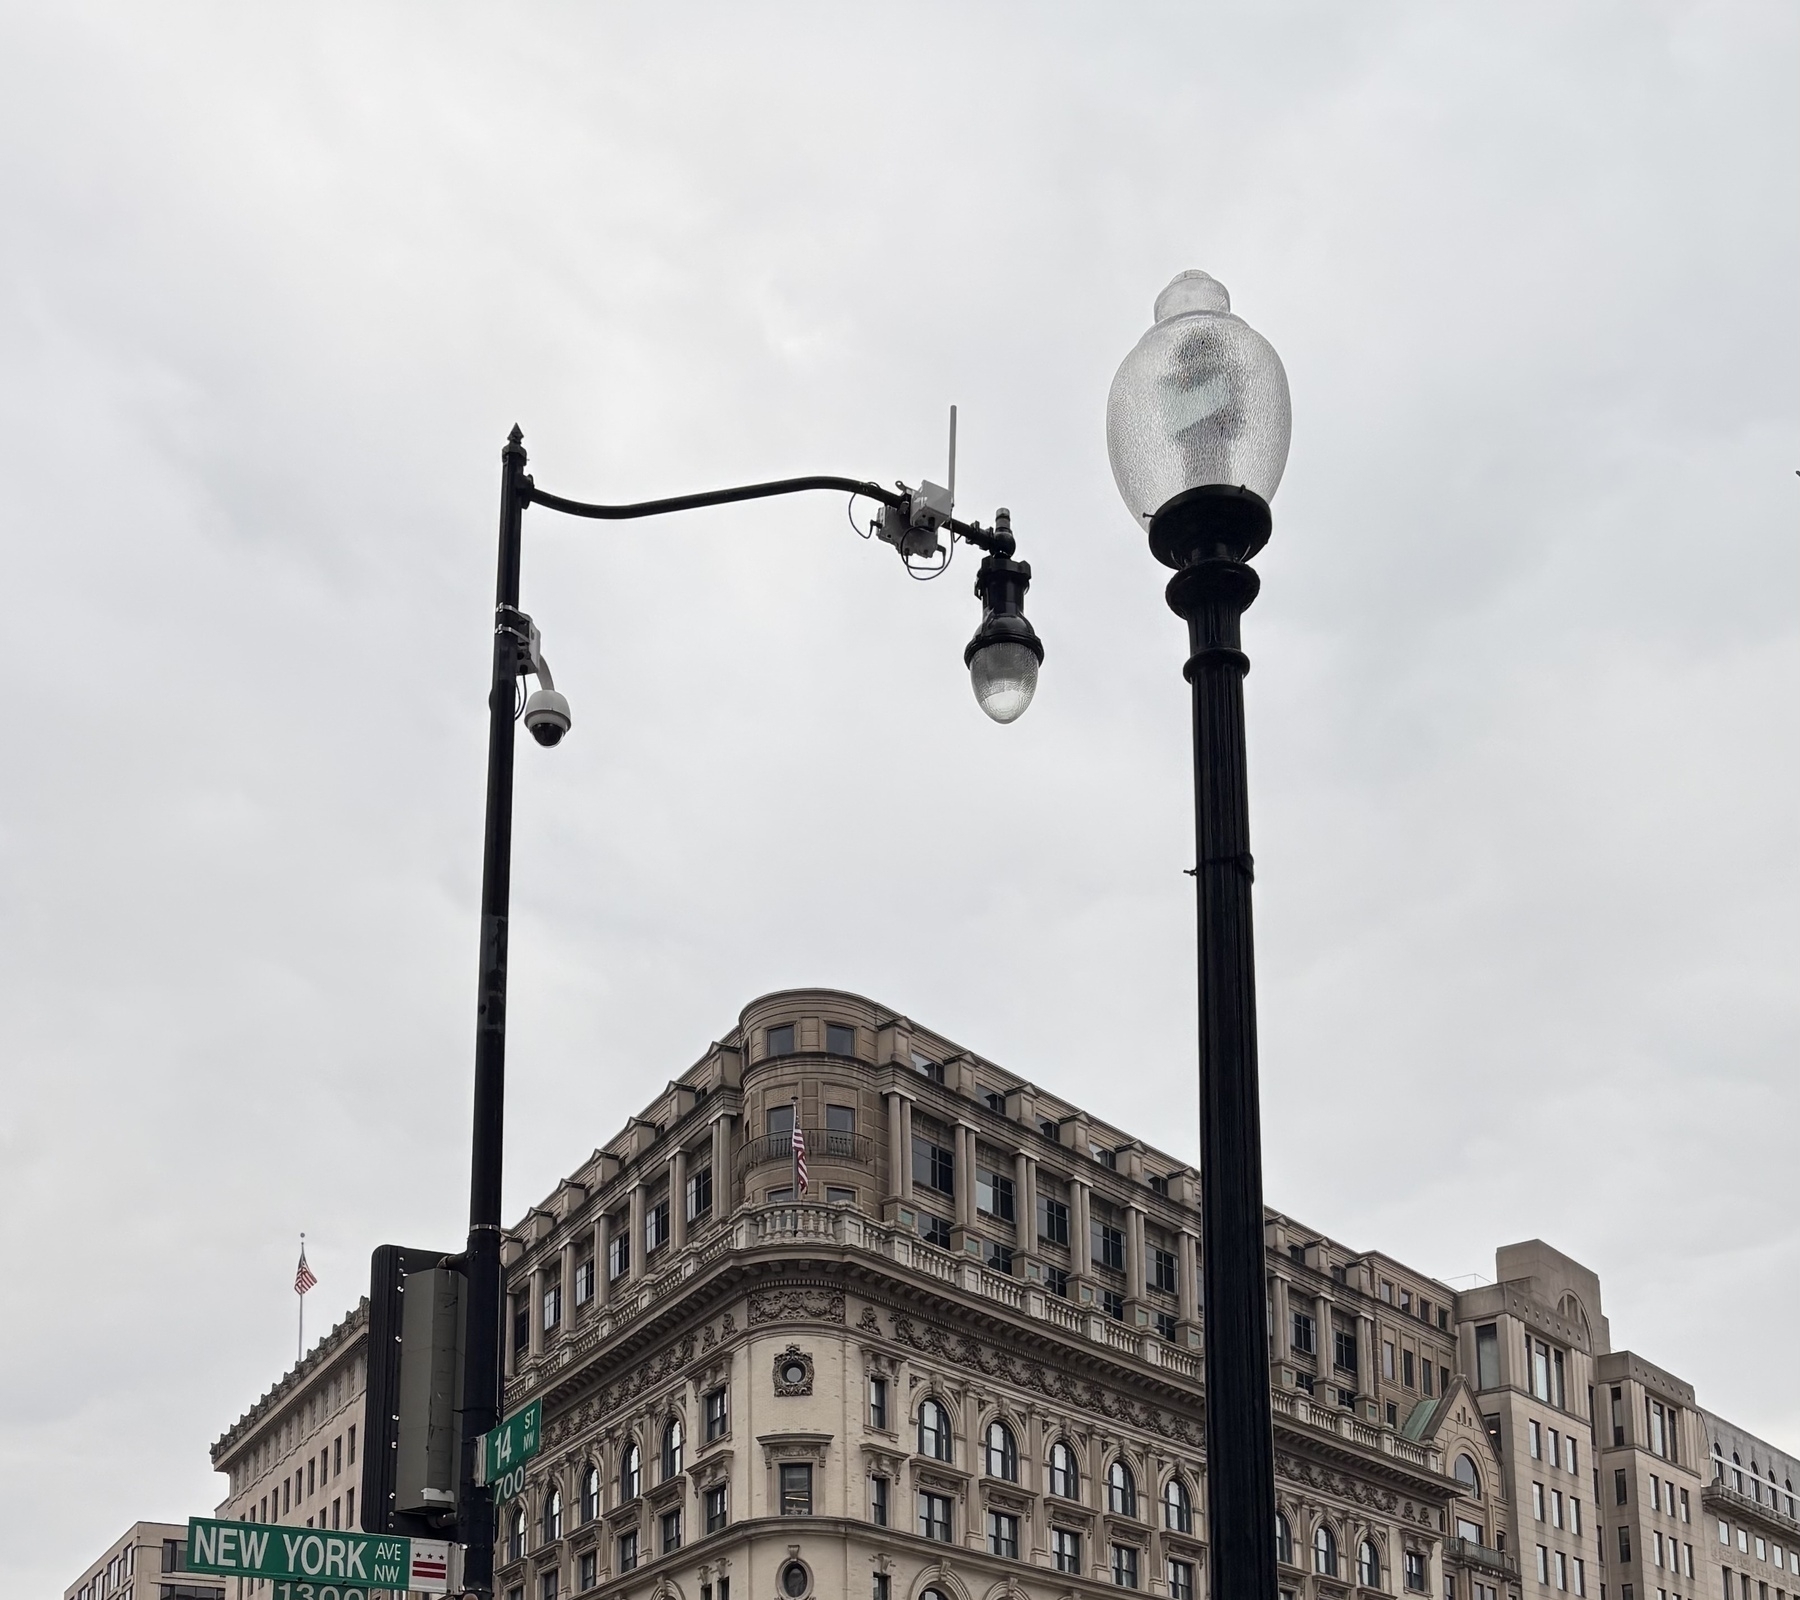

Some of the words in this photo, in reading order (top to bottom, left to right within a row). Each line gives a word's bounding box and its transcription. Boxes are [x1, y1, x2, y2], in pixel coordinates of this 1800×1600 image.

[495, 1425, 512, 1470] 14
[524, 1408, 535, 1430] ST
[523, 1430, 535, 1452] NW
[494, 1465, 525, 1505] 700
[194, 1525, 270, 1570] NEW
[283, 1534, 368, 1580] YORK
[375, 1542, 402, 1561] AVE
[374, 1564, 400, 1583] NW
